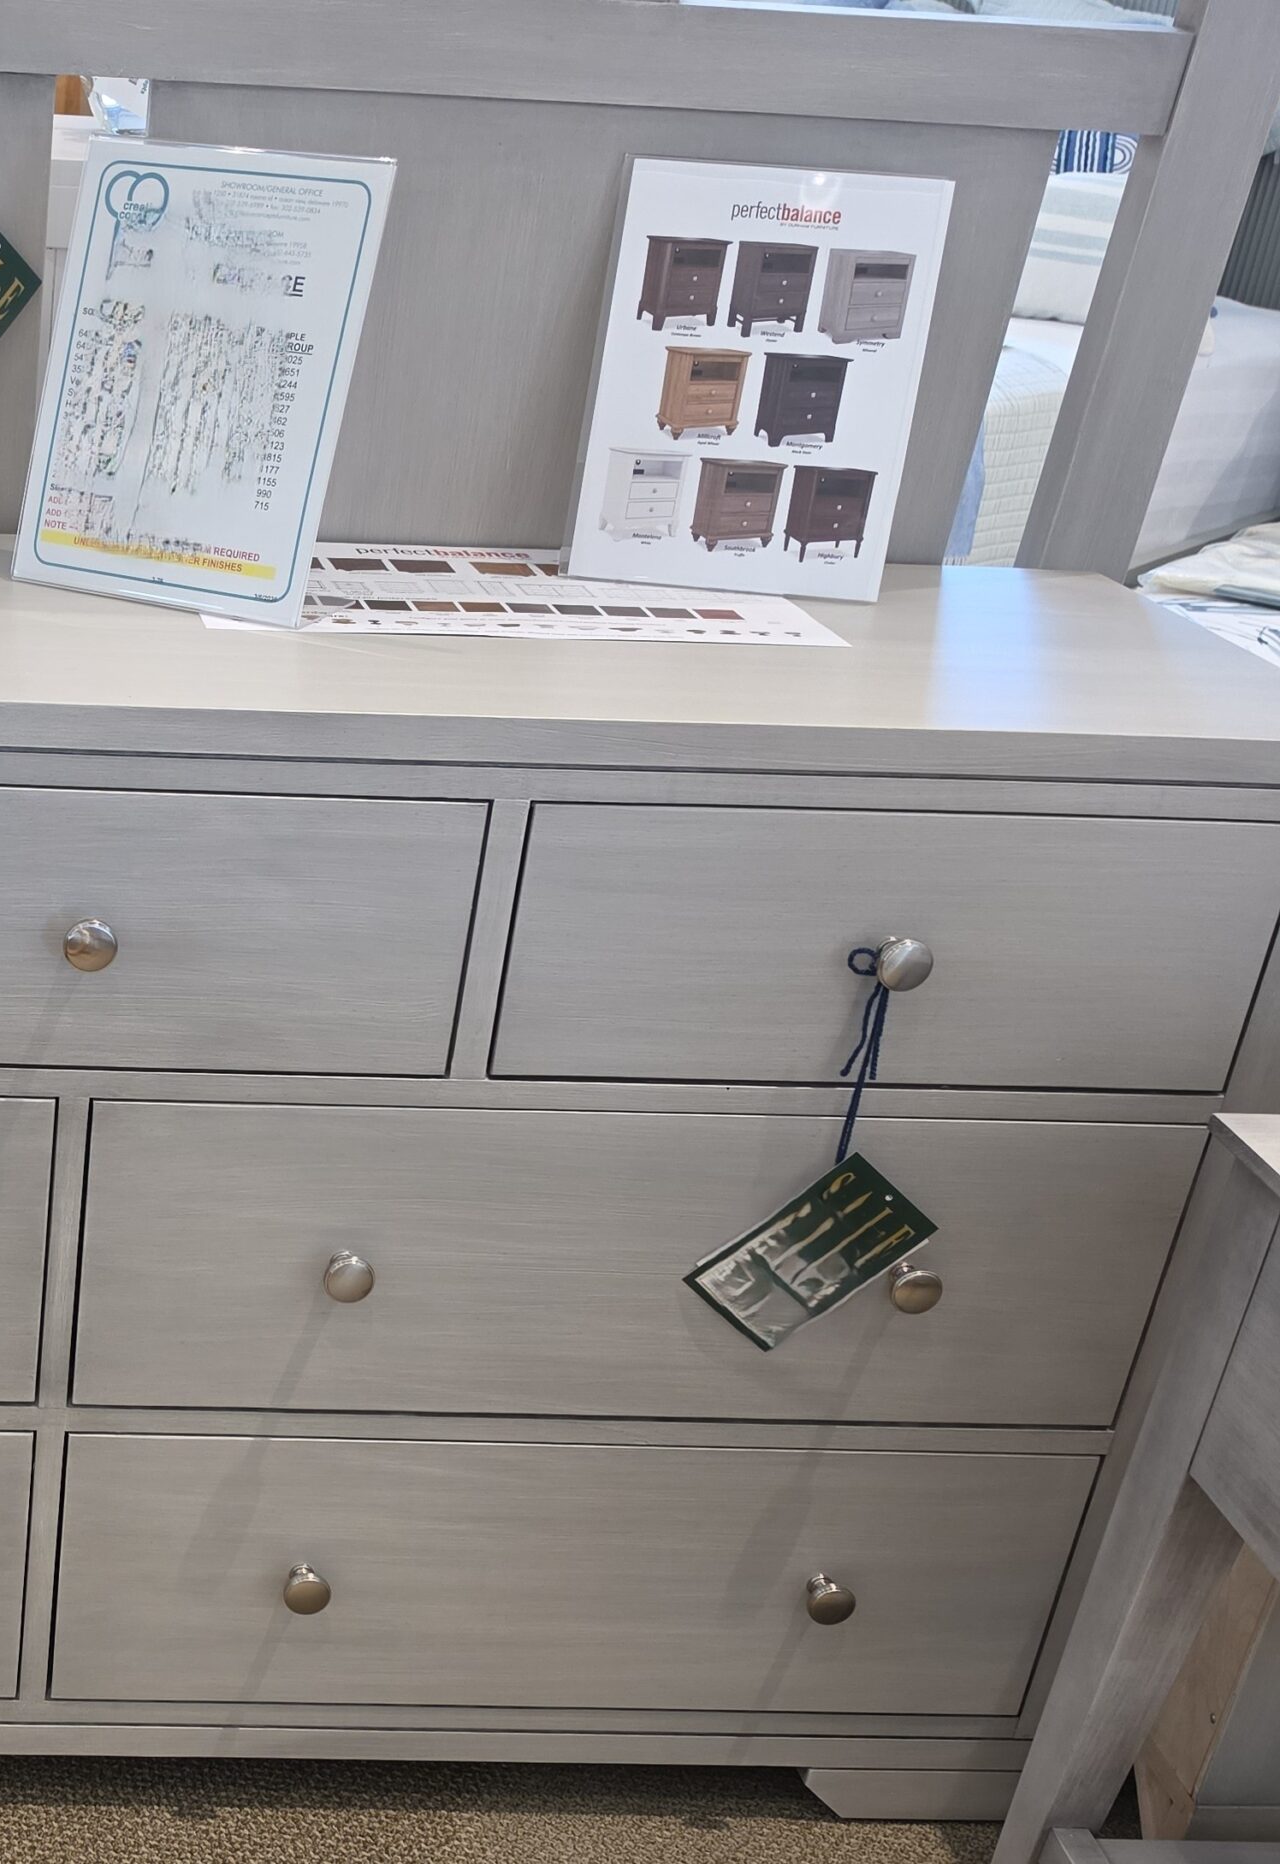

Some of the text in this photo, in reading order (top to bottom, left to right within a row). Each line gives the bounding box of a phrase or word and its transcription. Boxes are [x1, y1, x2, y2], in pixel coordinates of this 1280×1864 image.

[298, 187, 324, 197] OFFICE
[731, 200, 842, 226] perfectbalance
[286, 342, 314, 353] ROUP
[258, 477, 276, 487] 1155
[257, 489, 272, 499] 990
[254, 500, 269, 511] 715
[44, 519, 67, 530] NOTE
[214, 547, 260, 562] REQUIRED
[202, 558, 243, 573] FINISHES
